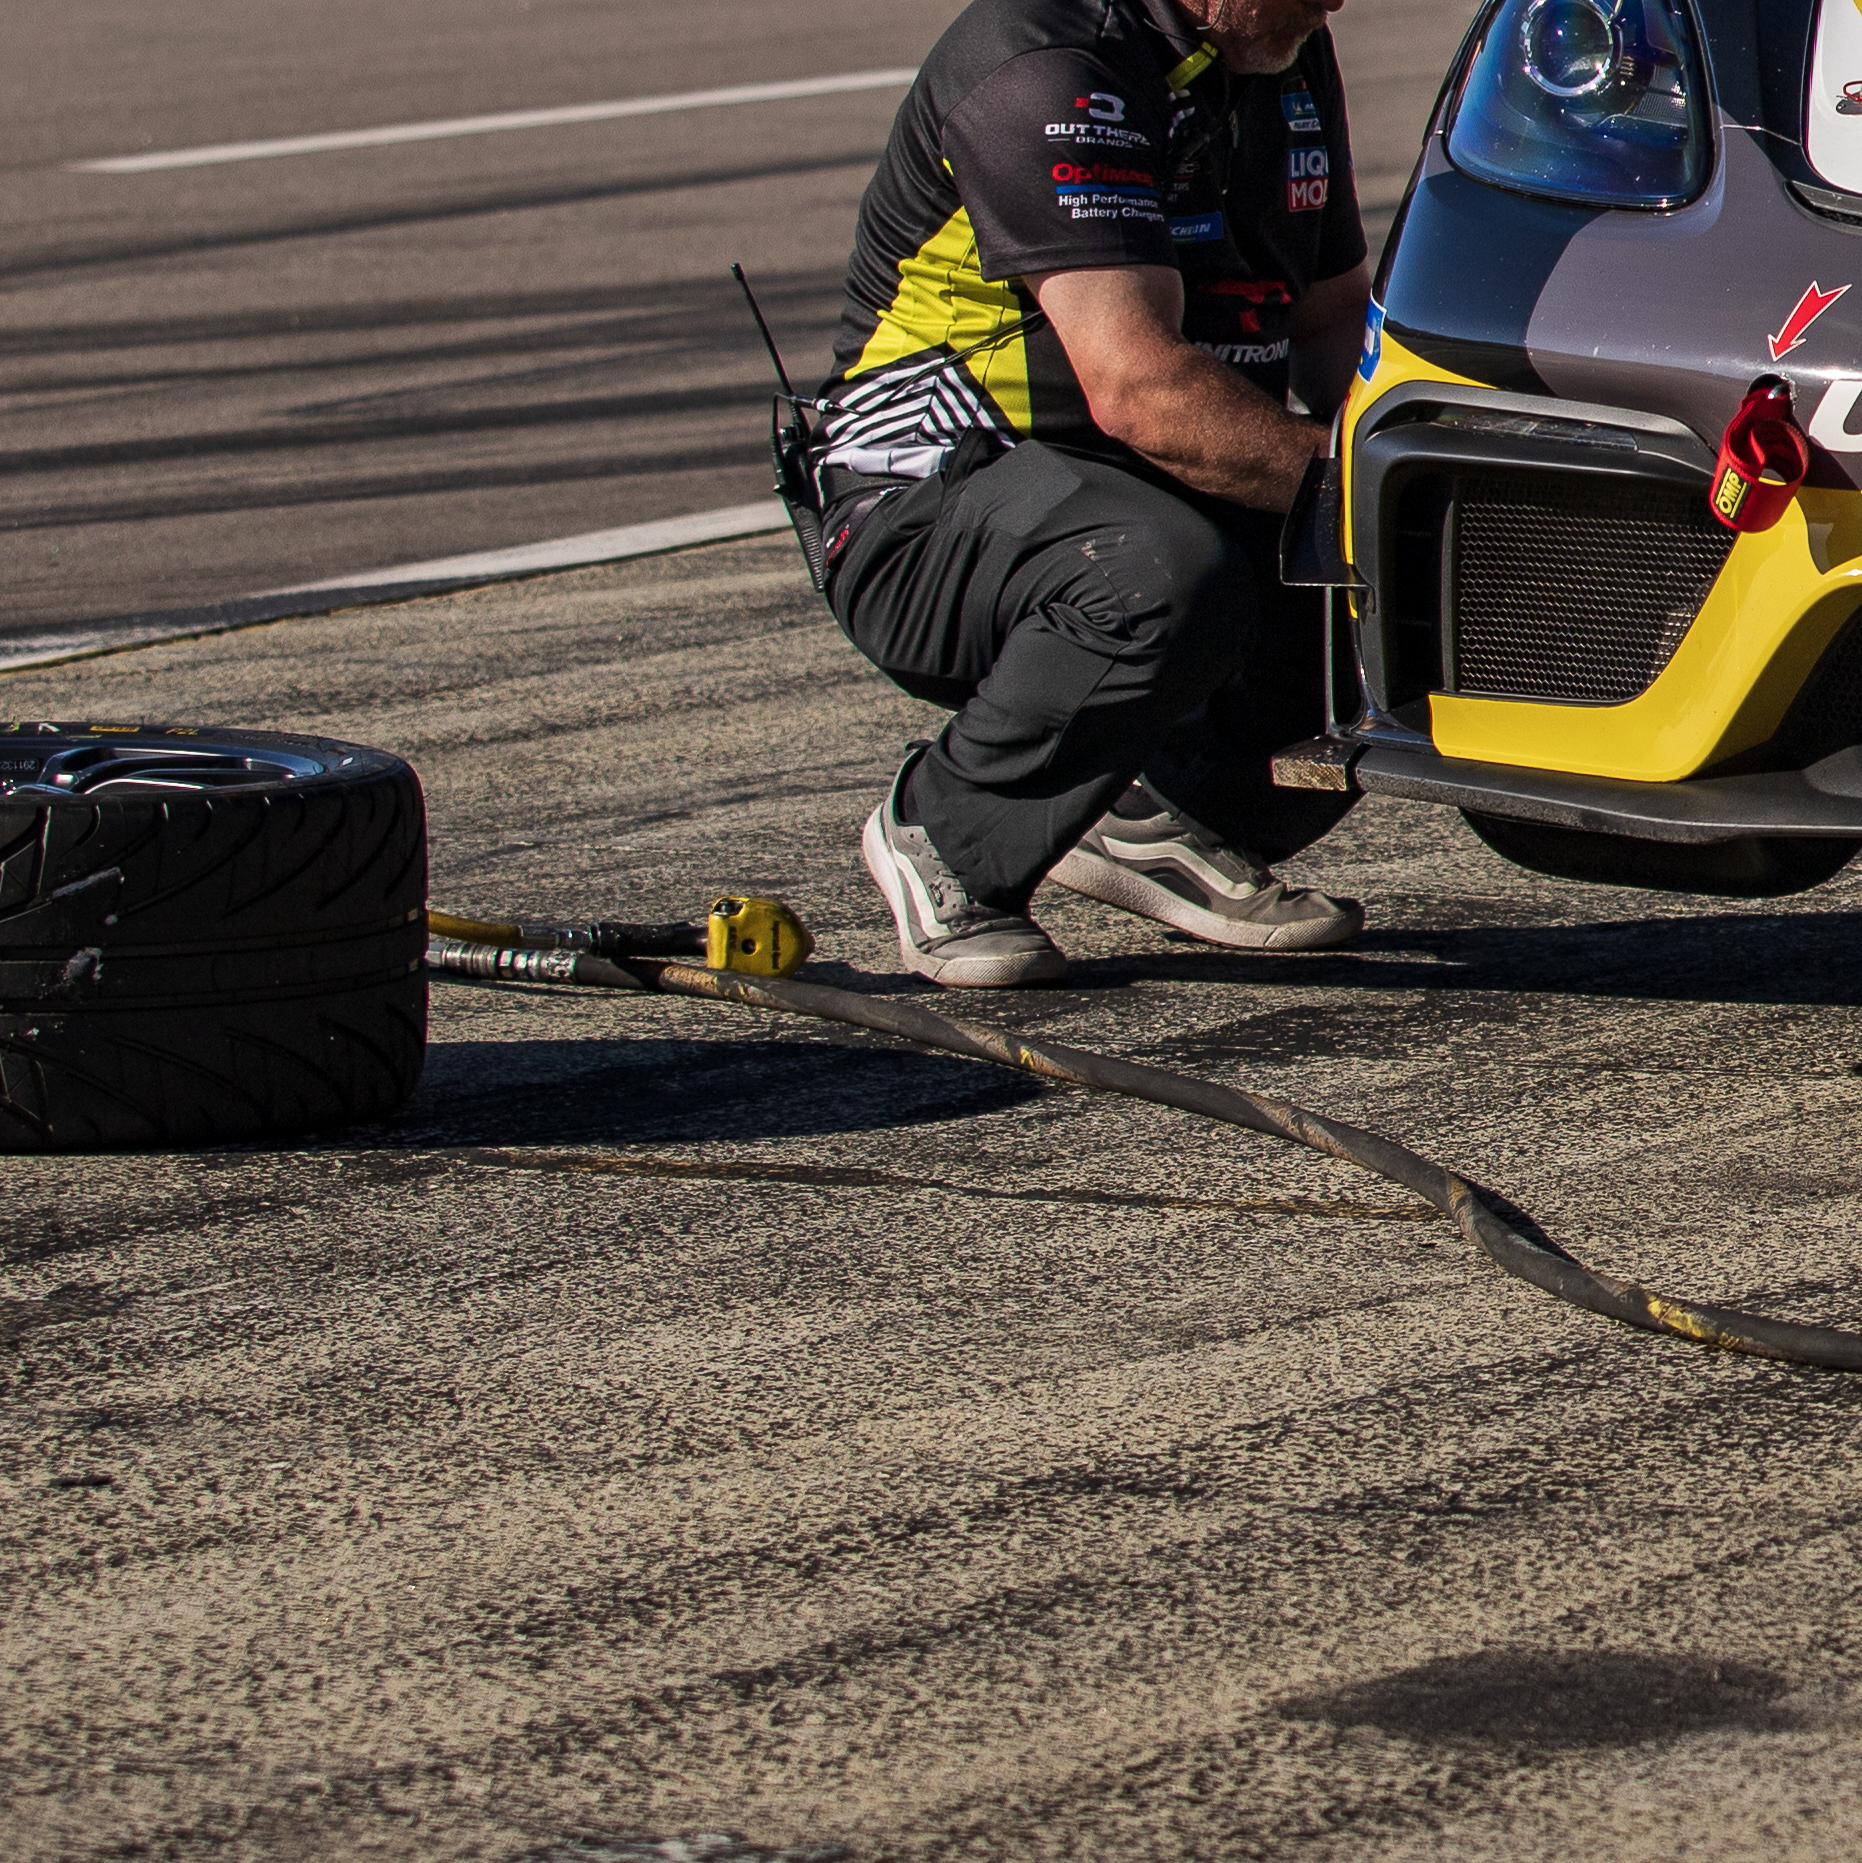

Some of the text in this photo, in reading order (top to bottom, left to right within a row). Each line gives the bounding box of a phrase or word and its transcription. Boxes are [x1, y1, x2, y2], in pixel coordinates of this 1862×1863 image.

[1044, 124, 1091, 136] OUT
[1075, 136, 1134, 149] BRANDS
[1291, 179, 1329, 208] MOL
[1058, 194, 1089, 210] High
[1071, 207, 1119, 220] Battery
[1170, 222, 1211, 236] CHELIN
[1719, 472, 1742, 514] OMP
